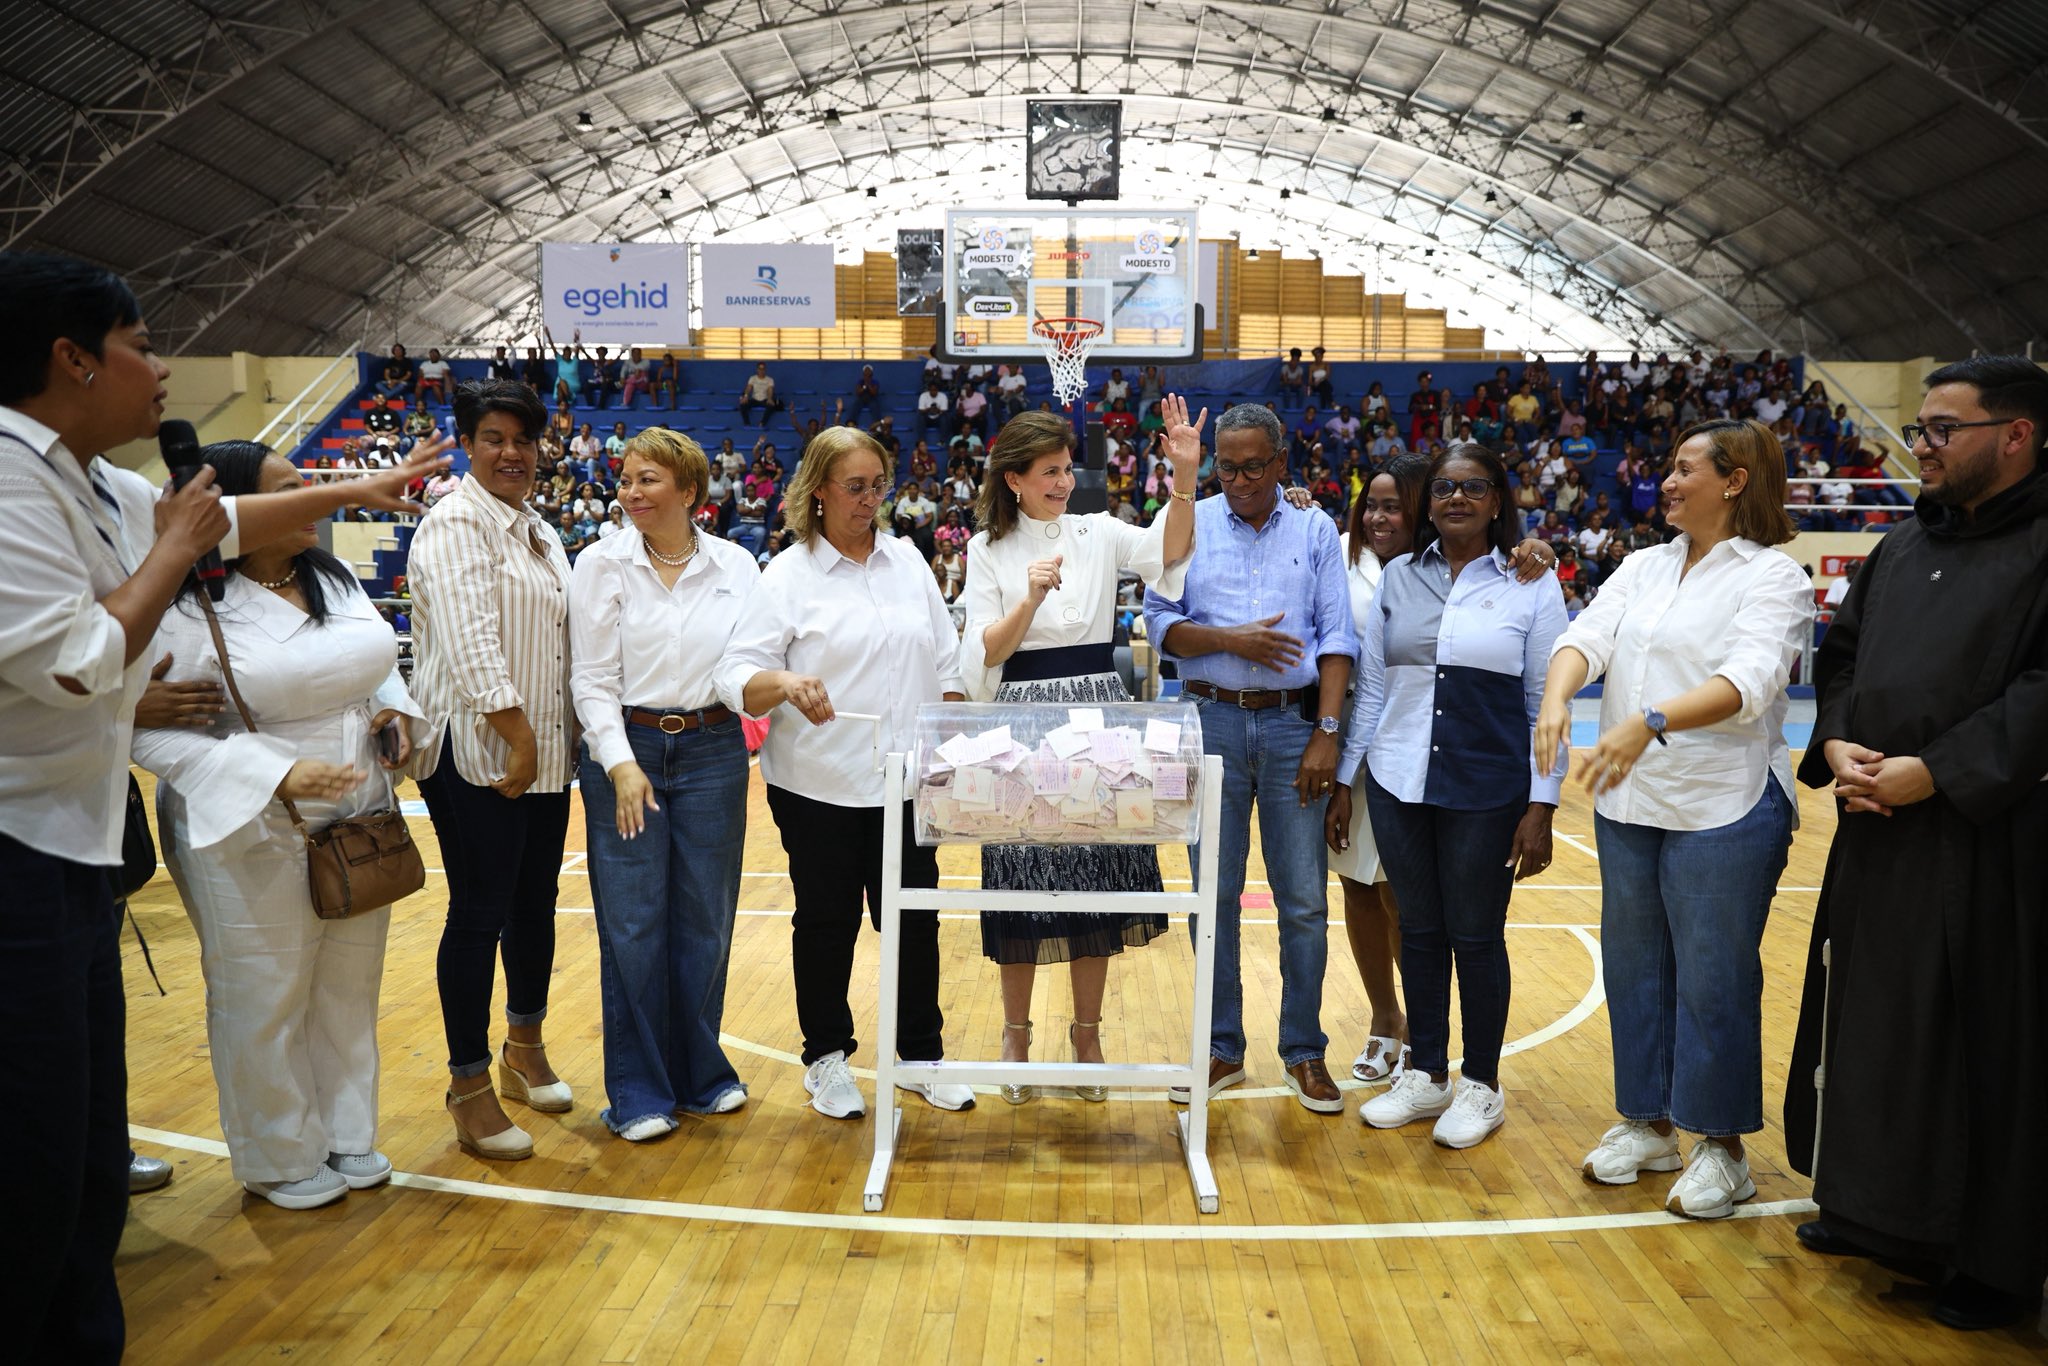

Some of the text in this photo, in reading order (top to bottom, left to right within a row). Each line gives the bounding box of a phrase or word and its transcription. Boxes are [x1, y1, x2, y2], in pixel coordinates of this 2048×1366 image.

[898, 234, 932, 245] LOCAL
[969, 255, 1014, 263] MODESTO
[1125, 259, 1171, 268] MODESTO
[564, 281, 667, 316] egehid
[725, 296, 811, 306] BANRESERVAS
